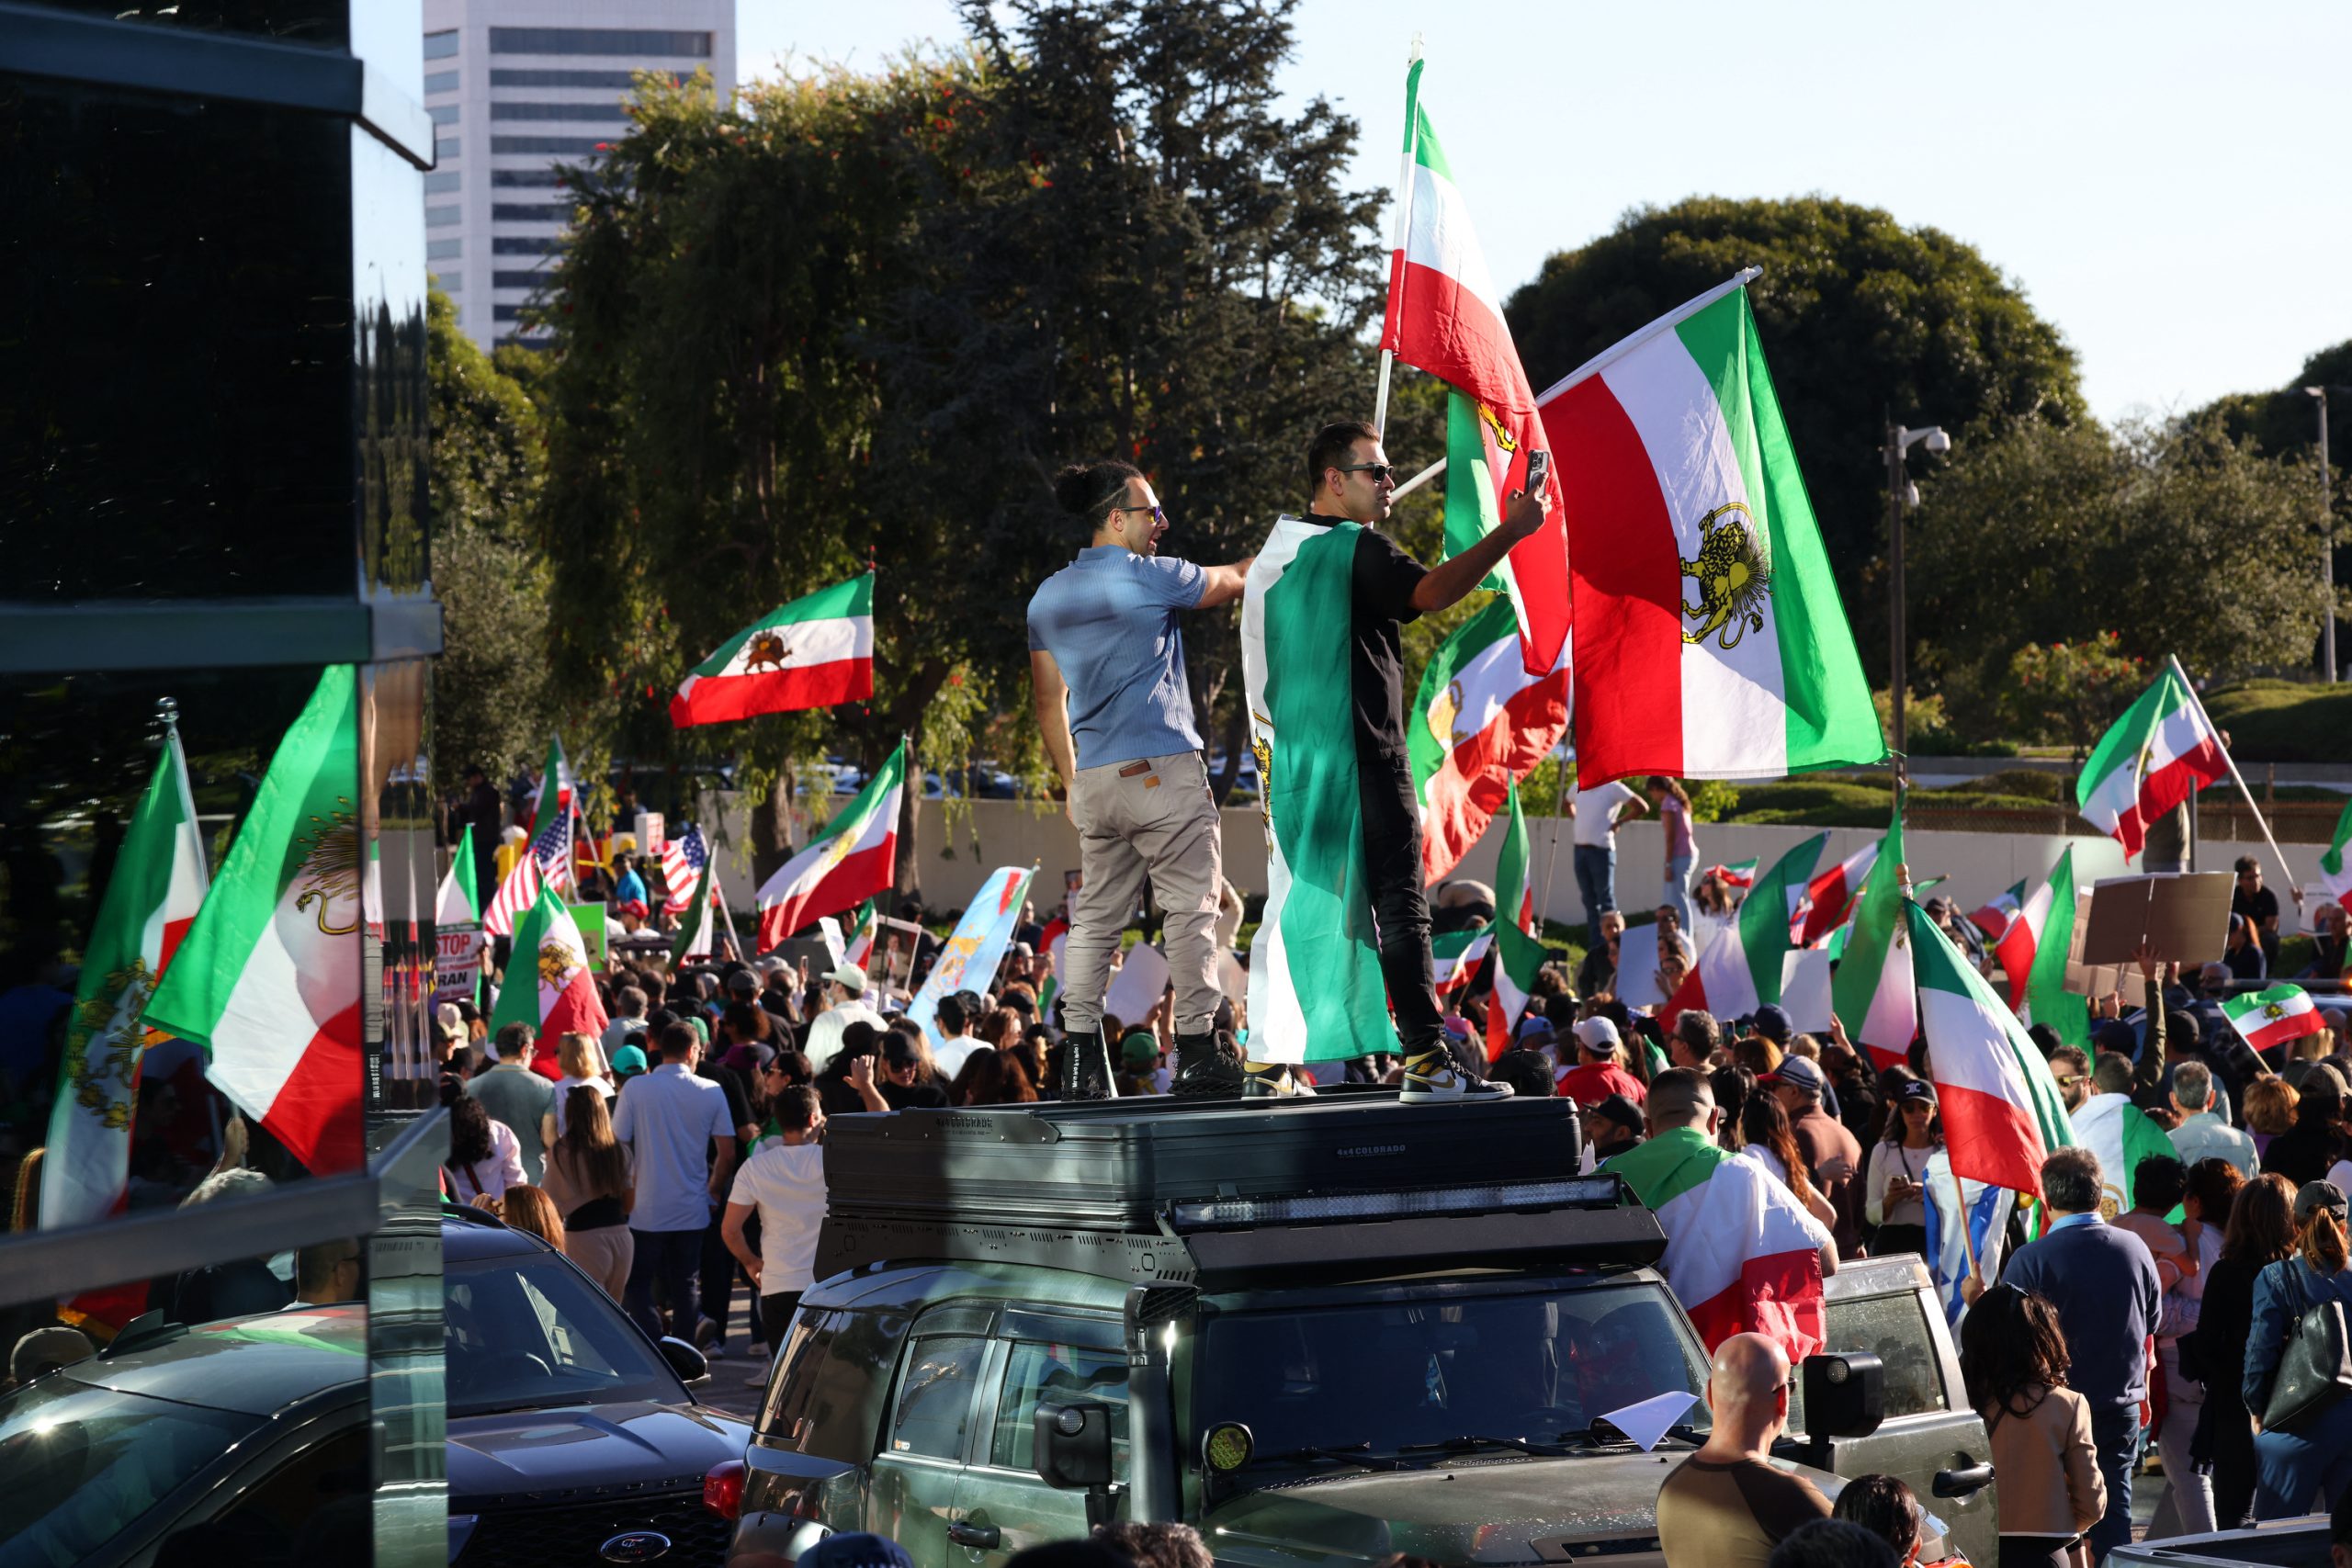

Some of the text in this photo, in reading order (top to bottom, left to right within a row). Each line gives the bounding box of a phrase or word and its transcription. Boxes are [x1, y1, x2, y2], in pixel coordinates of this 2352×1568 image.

[435, 933, 471, 955] STOP
[438, 972, 468, 988] RAN
[1355, 1144, 1407, 1155] COLORADO
